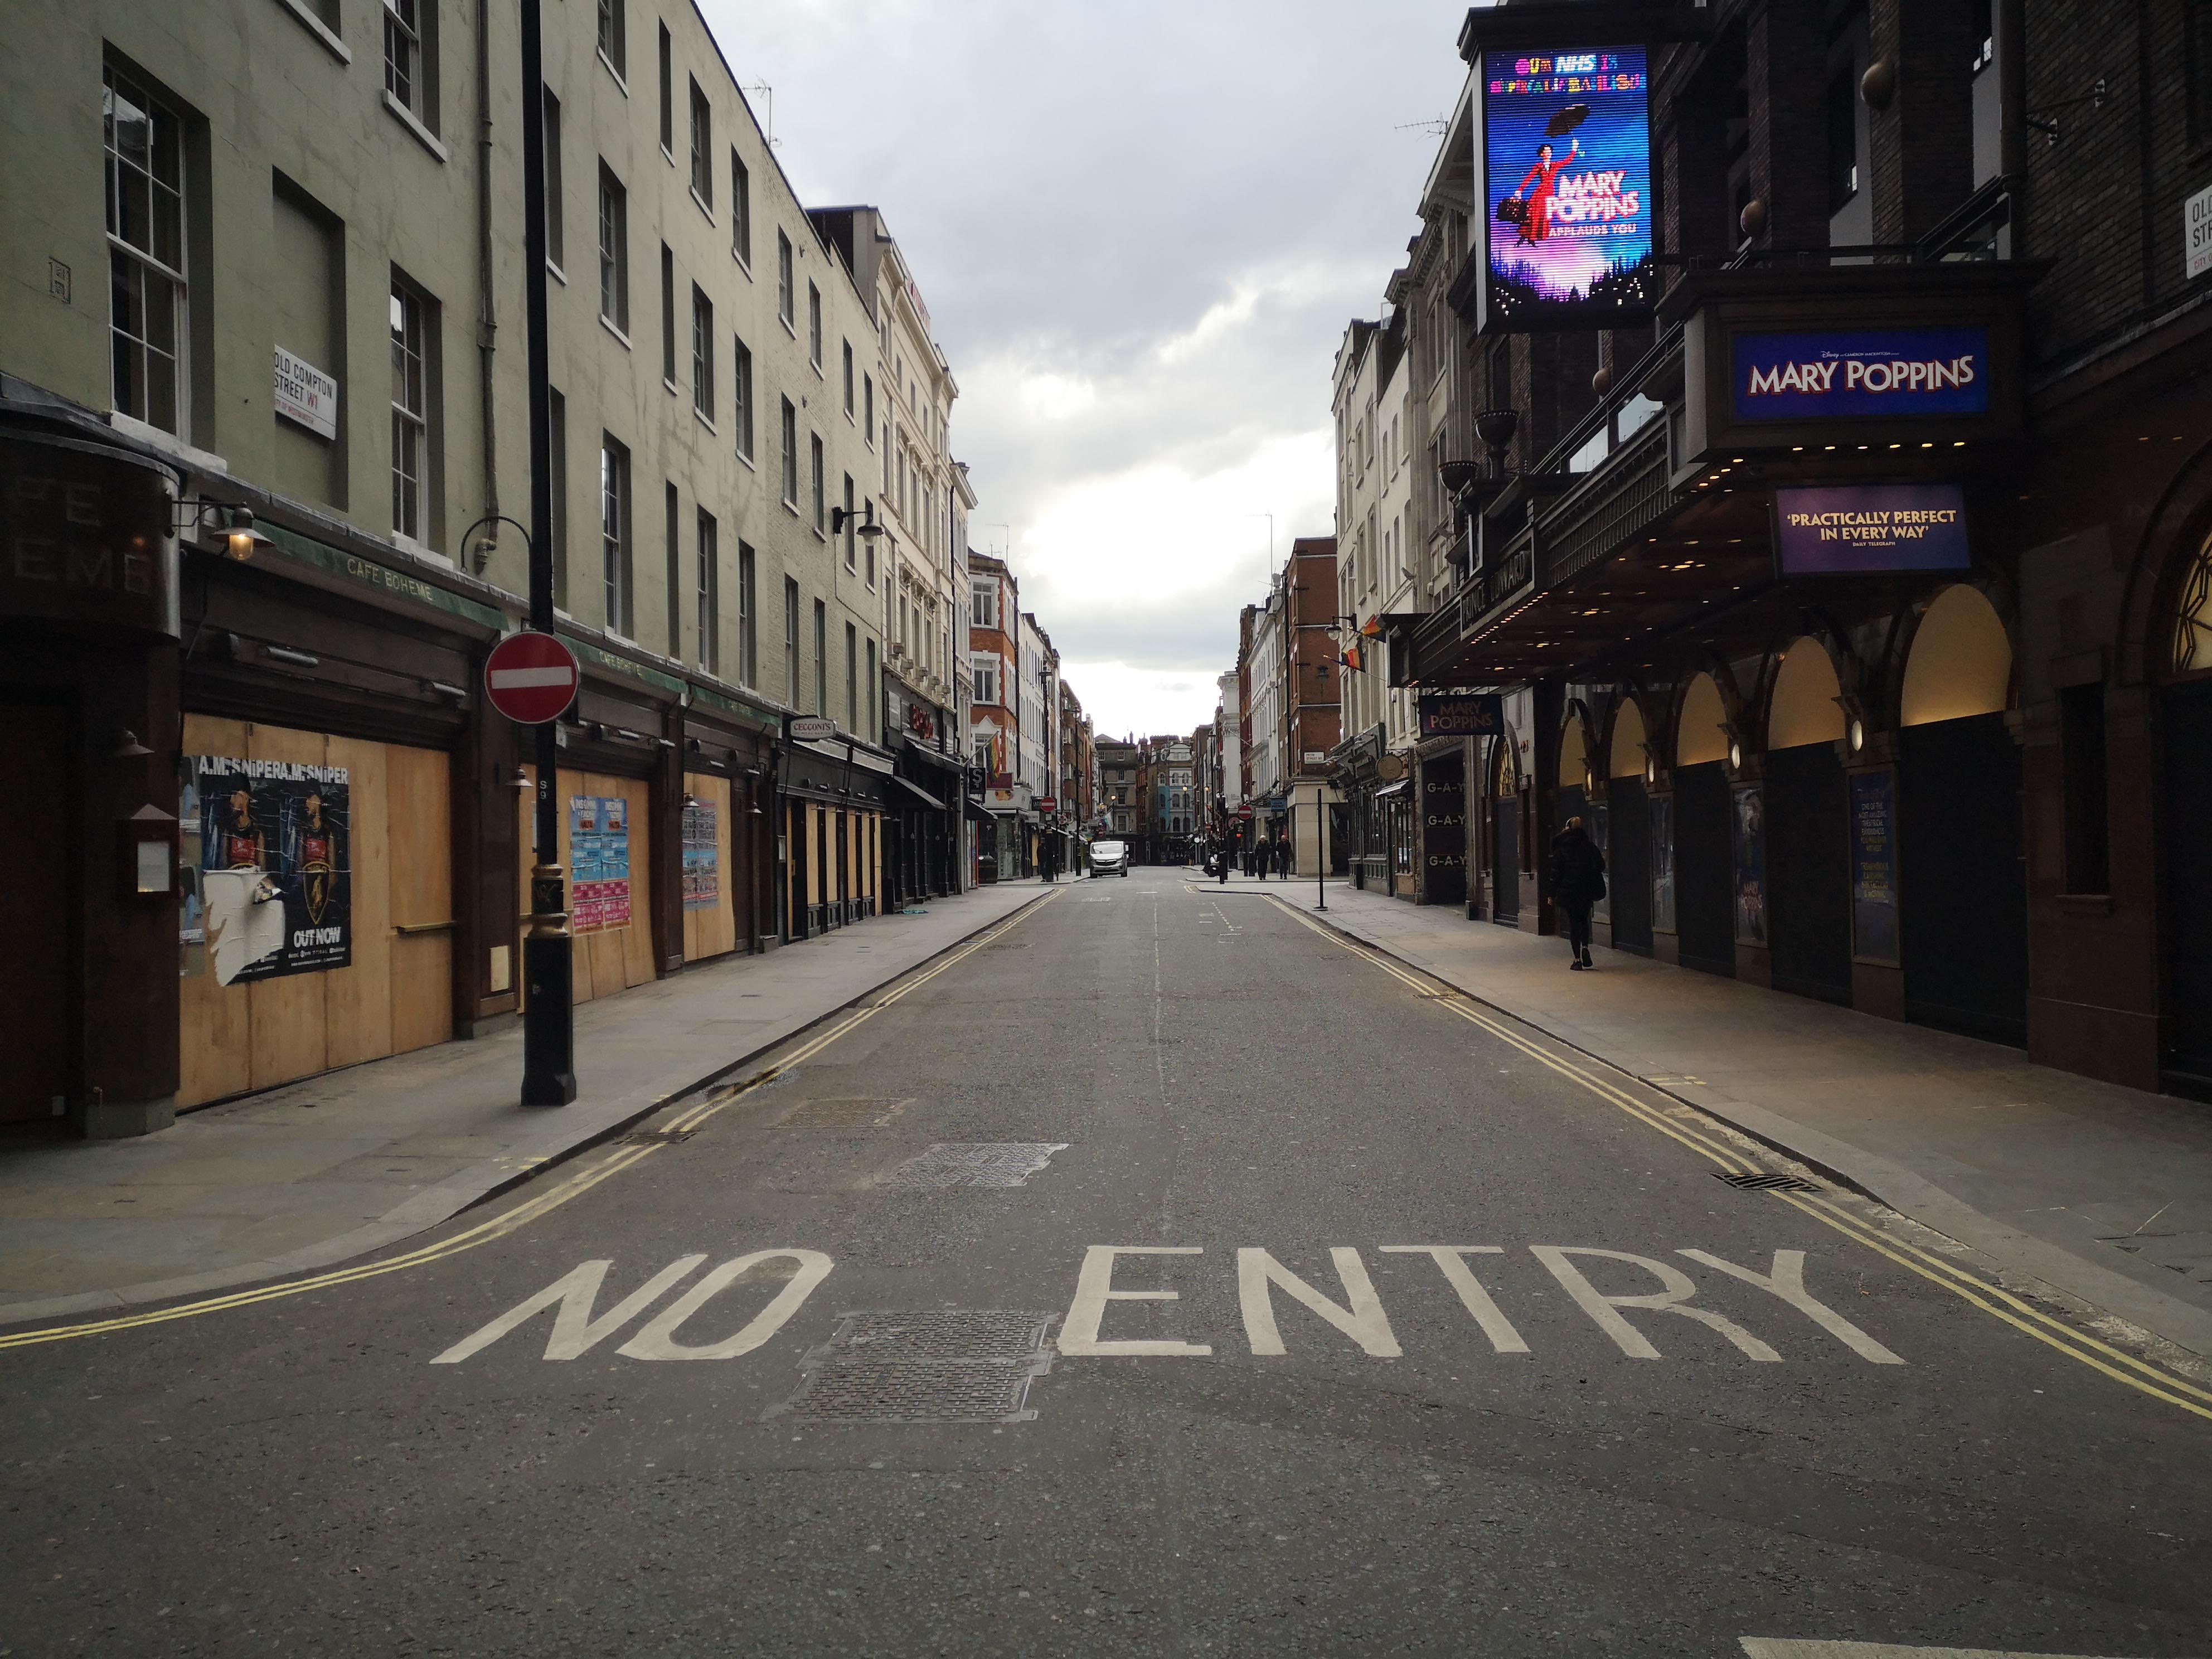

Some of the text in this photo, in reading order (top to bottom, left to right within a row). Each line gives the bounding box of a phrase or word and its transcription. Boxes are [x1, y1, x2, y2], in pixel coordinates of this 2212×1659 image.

[1555, 55, 1597, 74] NHS
[1558, 170, 1627, 196] MARY
[1545, 191, 1640, 223] POPPINS
[1611, 223, 1637, 234] YOU
[2194, 257, 2206, 271] CITY
[1820, 351, 1840, 359] Disney
[275, 352, 333, 400] OLD COMPTON
[1749, 355, 1974, 394] MARY POPPINS
[275, 372, 318, 410] STREET W1
[1894, 510, 1957, 523] PERFECT
[1820, 528, 1838, 540] IN
[1842, 526, 1889, 540] EVERY
[385, 571, 435, 601] BOHEME
[1439, 701, 1481, 716] MARY
[793, 722, 831, 731] CECCONI'S
[1430, 714, 1493, 730] POPPINS
[1427, 782, 1464, 793] G-A-Y
[1428, 814, 1465, 826] G-A-Y
[1429, 856, 1467, 866] G-A-Y
[293, 926, 341, 948] OUT NOW
[429, 1244, 1905, 1365] NO ENTRY
